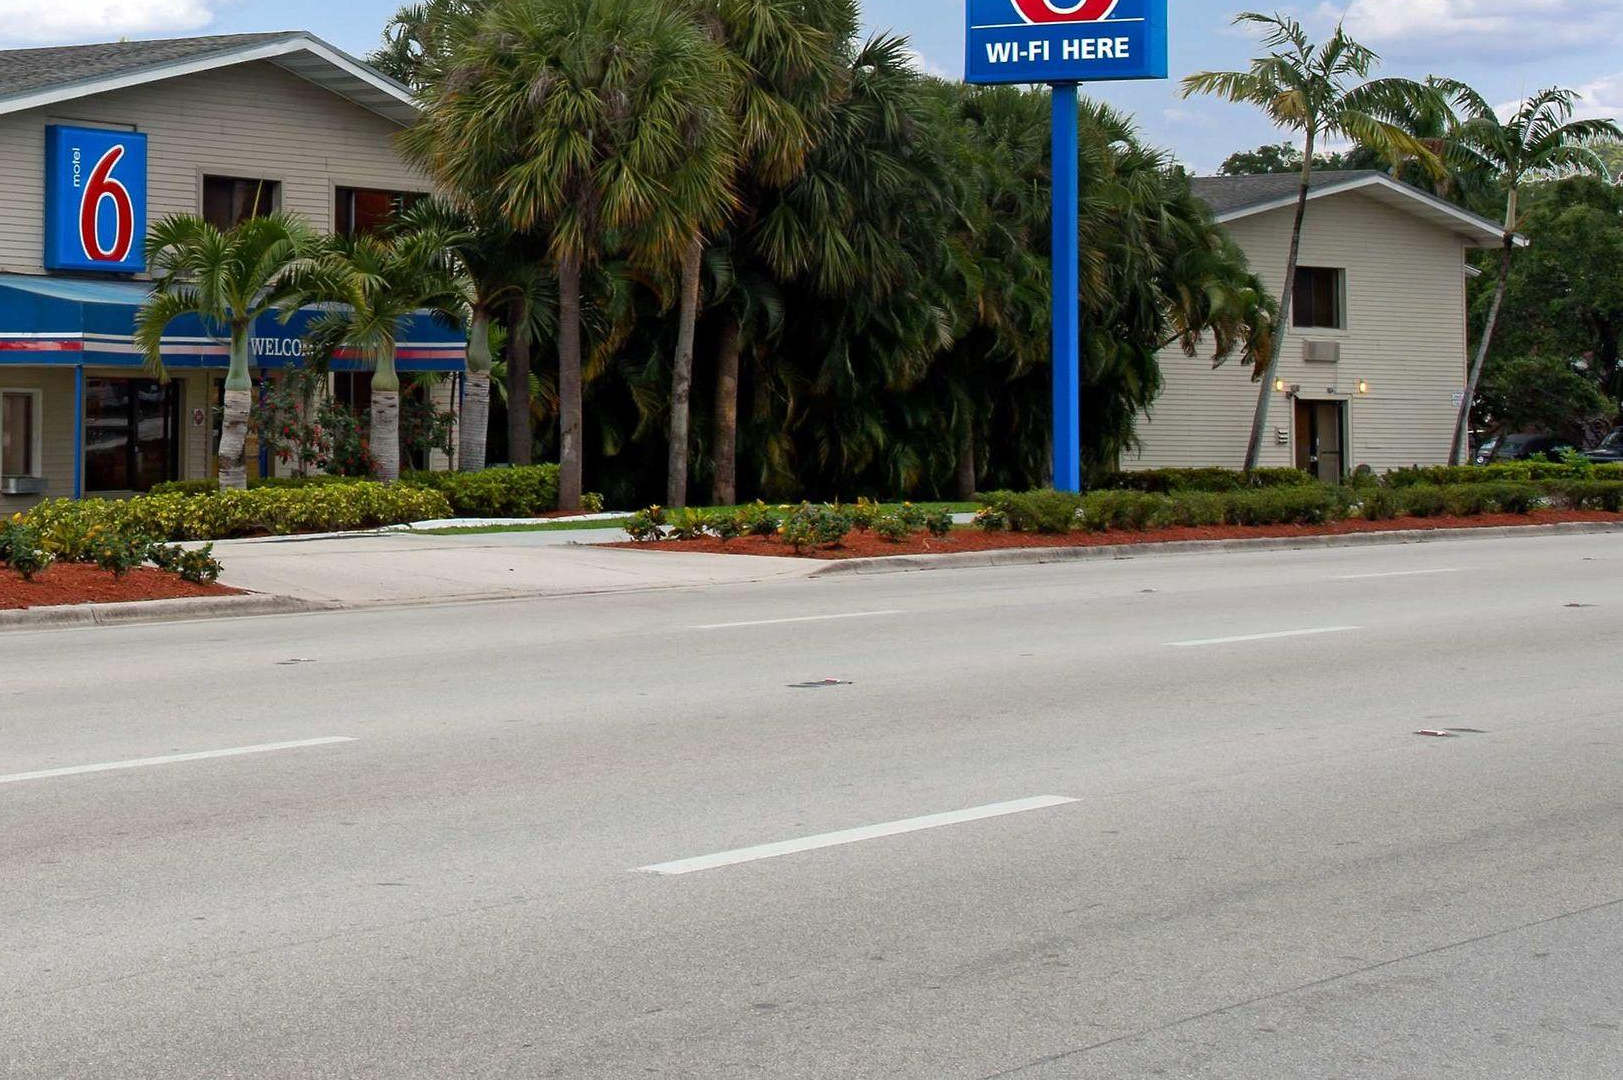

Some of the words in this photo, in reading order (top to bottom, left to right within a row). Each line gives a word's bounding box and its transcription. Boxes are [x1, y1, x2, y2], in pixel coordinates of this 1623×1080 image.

[986, 40, 1050, 64] WI-FI
[1062, 36, 1130, 60] HERE
[72, 147, 81, 188] motel
[79, 144, 134, 262] 6
[250, 337, 322, 357] WELCO
